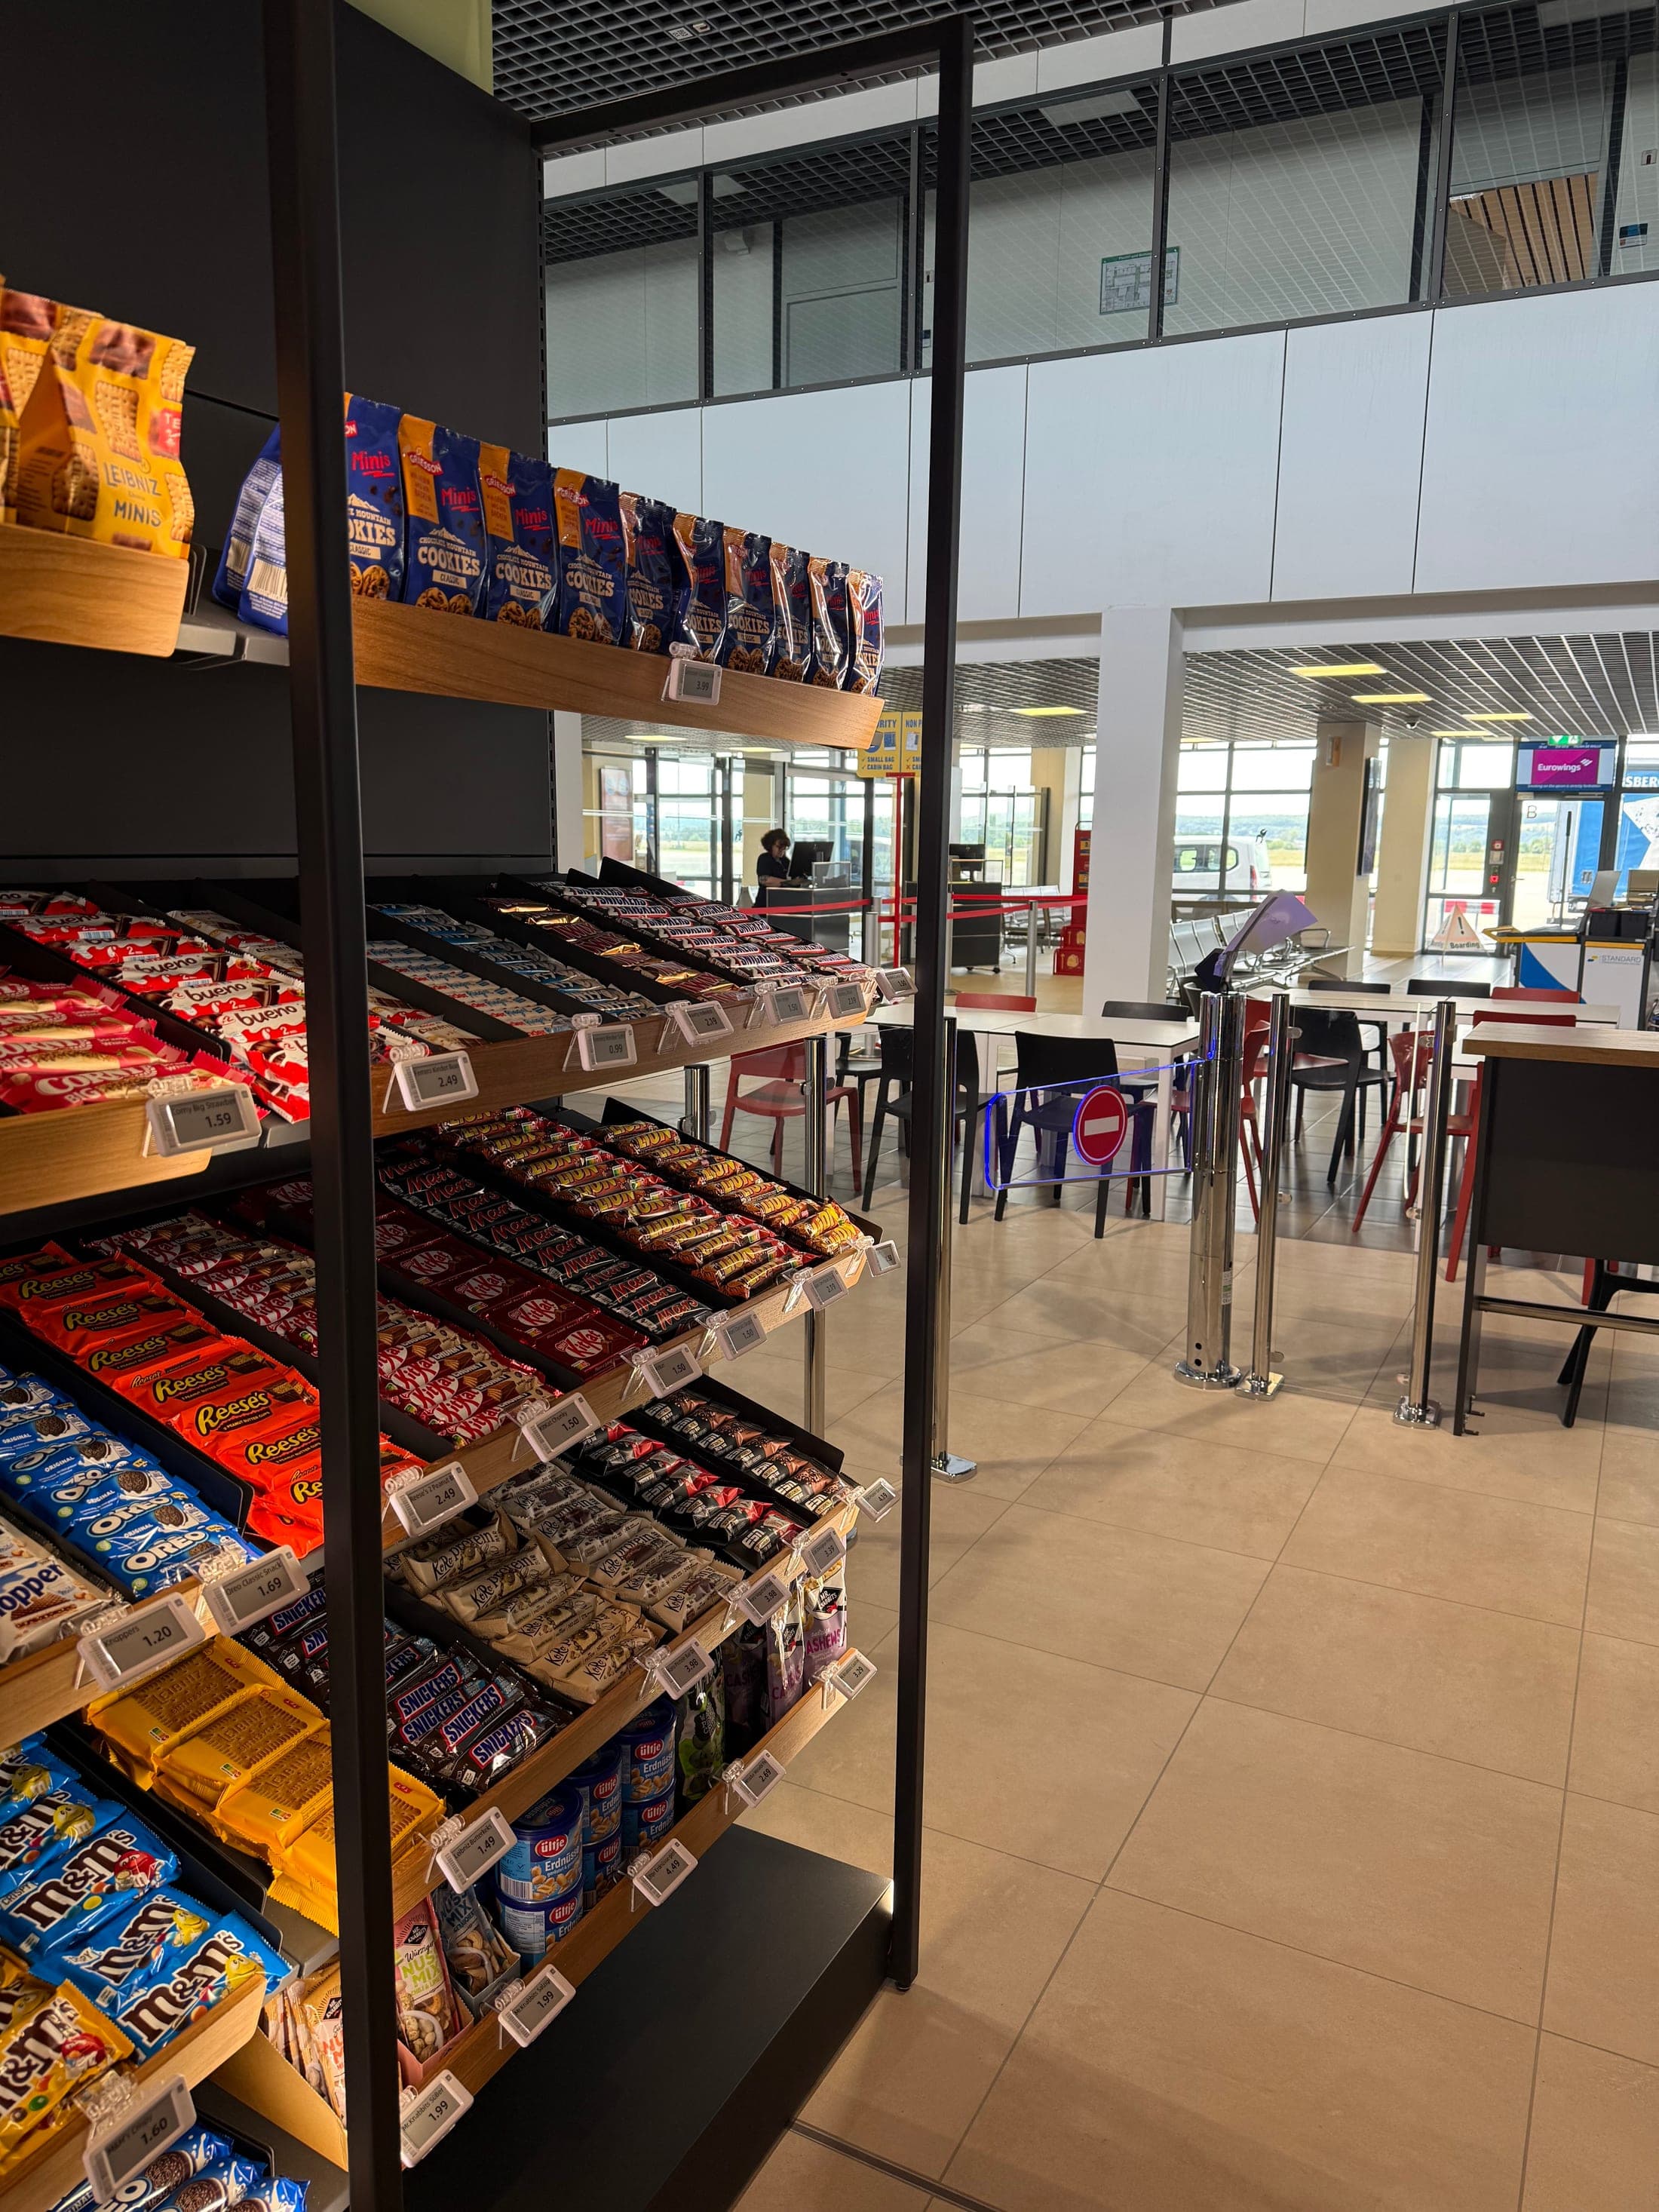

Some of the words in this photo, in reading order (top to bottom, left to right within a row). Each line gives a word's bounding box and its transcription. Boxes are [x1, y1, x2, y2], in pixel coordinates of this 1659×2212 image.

[351, 452, 391, 470] Minis
[409, 454, 442, 474] GRIESSON
[103, 462, 161, 497] LEIBNIZ
[485, 477, 515, 495] GRIESSON
[441, 489, 476, 506] Minis
[115, 501, 161, 527] MINIS
[516, 508, 547, 526] Minis
[585, 518, 618, 534] Minis
[418, 547, 480, 576] COOKIES
[495, 563, 552, 589] COOKIES
[566, 573, 615, 596] COOKIES
[1538, 763, 1581, 772] Eurowings
[1526, 805, 1537, 818] B
[136, 956, 198, 975] bueno
[1602, 955, 1642, 963] STANDARD
[187, 981, 247, 1002] bueno
[237, 1004, 298, 1026] bueno
[609, 1044, 623, 1054] 0.99
[438, 1075, 458, 1088] 2.49
[65, 1087, 101, 1105] BIG
[193, 1103, 205, 1112] Big
[205, 1112, 232, 1128] 1.59
[495, 1134, 536, 1150] LION
[639, 1129, 672, 1150] LION
[530, 1155, 572, 1176] LION
[558, 1164, 599, 1186] LION
[704, 1161, 736, 1180] LION
[722, 1172, 754, 1192] LION
[426, 1179, 476, 1206] Mars
[596, 1191, 635, 1211] LION
[449, 1192, 500, 1220] Mars
[763, 1195, 792, 1214] LION
[468, 1203, 516, 1231] Mars
[491, 1213, 541, 1244] Mars
[517, 1226, 560, 1253] Mars
[538, 1235, 584, 1267] Mars
[410, 1251, 449, 1275] KitKat
[562, 1247, 607, 1278] Mars
[19, 1271, 94, 1299] Reese's
[465, 1275, 503, 1300] KitKat
[610, 1271, 656, 1302] Mars
[632, 1284, 676, 1315] Mars
[63, 1302, 140, 1331] Reese's
[519, 1298, 554, 1326] KitKat
[656, 1297, 698, 1330] Mars
[566, 1330, 603, 1358] KitKat
[742, 1330, 754, 1340] 1.50
[89, 1336, 167, 1371] Reese's
[432, 1345, 467, 1361] CHUNKY
[392, 1358, 437, 1389] KitKat
[452, 1362, 486, 1378] CHUNKY
[673, 1363, 686, 1375] 1.50
[154, 1366, 226, 1403] Reese's
[411, 1376, 458, 1409] KitKat
[476, 1375, 511, 1391] CHUNKY
[196, 1392, 270, 1436] Reese's
[434, 1391, 482, 1422] KitKat
[226, 1419, 244, 1430] PEANUT
[456, 1407, 502, 1440] KitKat
[562, 1416, 579, 1431] 1.50
[2, 1433, 31, 1443] ORIGINAL
[247, 1427, 319, 1465] Reese's
[44, 1456, 75, 1473] ORIGINAL
[435, 1488, 455, 1505] 2.49
[124, 1523, 153, 1539] ORIGINAL
[124, 1530, 207, 1570] OREO
[226, 1585, 242, 1596] Oreo
[242, 1573, 264, 1589] Classic
[264, 1563, 282, 1577] Snack
[257, 1577, 282, 1597] 1.69
[765, 1590, 777, 1603] 3.98
[273, 1589, 326, 1630] SNICKER
[104, 1626, 141, 1646] Knoppers
[143, 1626, 172, 1647] 1.20
[685, 1659, 699, 1674] 3.98
[853, 1667, 864, 1678] 3.29
[399, 1665, 458, 1719] SNICKERS
[403, 1690, 466, 1742] SNICKERS
[444, 1688, 502, 1744] SNICKERS
[474, 1713, 532, 1764] SNICKERS
[640, 1742, 661, 1757] ültje
[759, 1769, 771, 1783] 2.69
[600, 1777, 618, 1796] ültje
[648, 1804, 666, 1820] ültje
[453, 1842, 471, 1860] Leibniz
[477, 1836, 496, 1855] 1.49
[541, 1837, 566, 1856] ültje
[667, 1859, 680, 1875] 4.49
[2, 1882, 32, 1909] CRISPY
[556, 1901, 576, 1920] ültje
[408, 1927, 428, 1944] KNABBITS
[404, 1942, 434, 1962] Würziger
[537, 1991, 554, 2008] 1.99
[402, 2101, 431, 2131] Mr.Knabbits
[430, 2087, 444, 2103] Süßer
[428, 2100, 449, 2121] 1.99
[141, 2117, 168, 2147] 1.60
